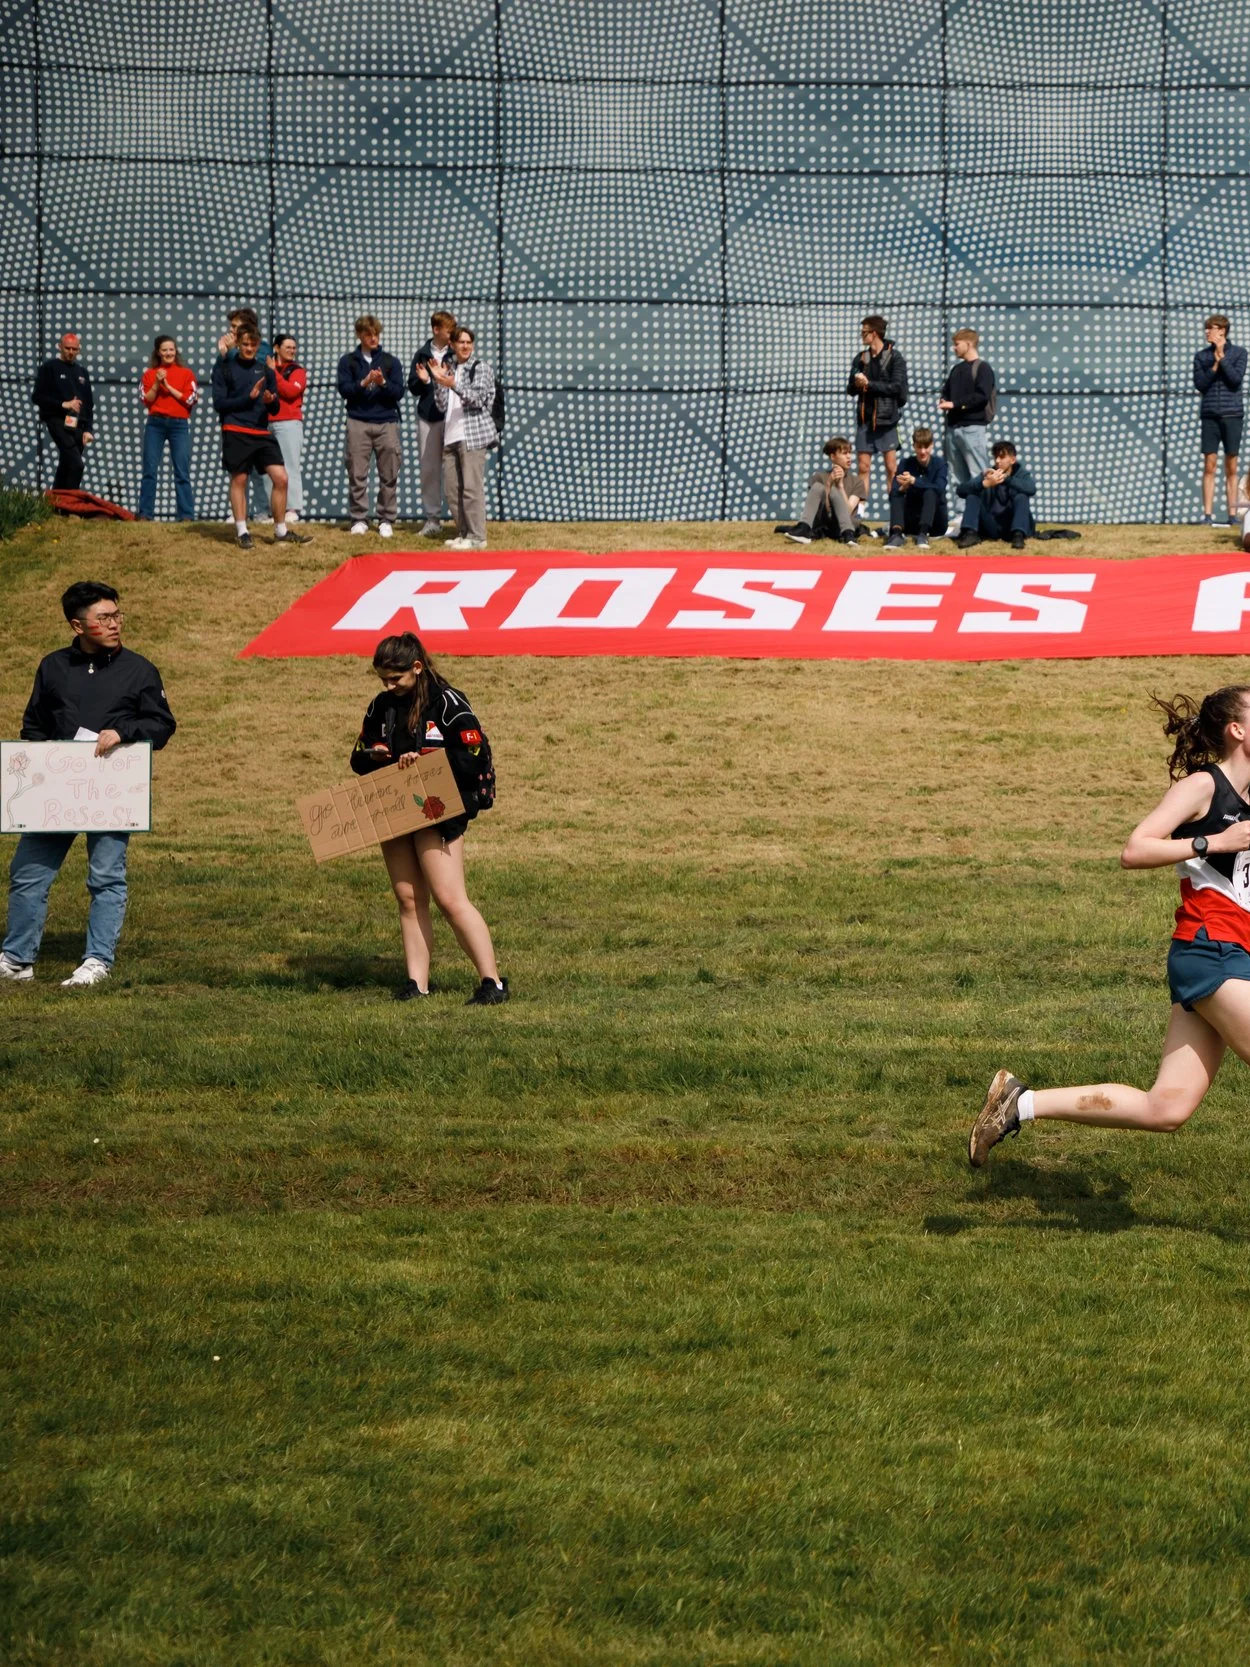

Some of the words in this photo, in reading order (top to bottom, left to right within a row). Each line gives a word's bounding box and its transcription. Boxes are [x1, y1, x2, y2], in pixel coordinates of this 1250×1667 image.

[331, 567, 1097, 634] ROSES
[45, 745, 87, 774] Go
[66, 777, 122, 800] The
